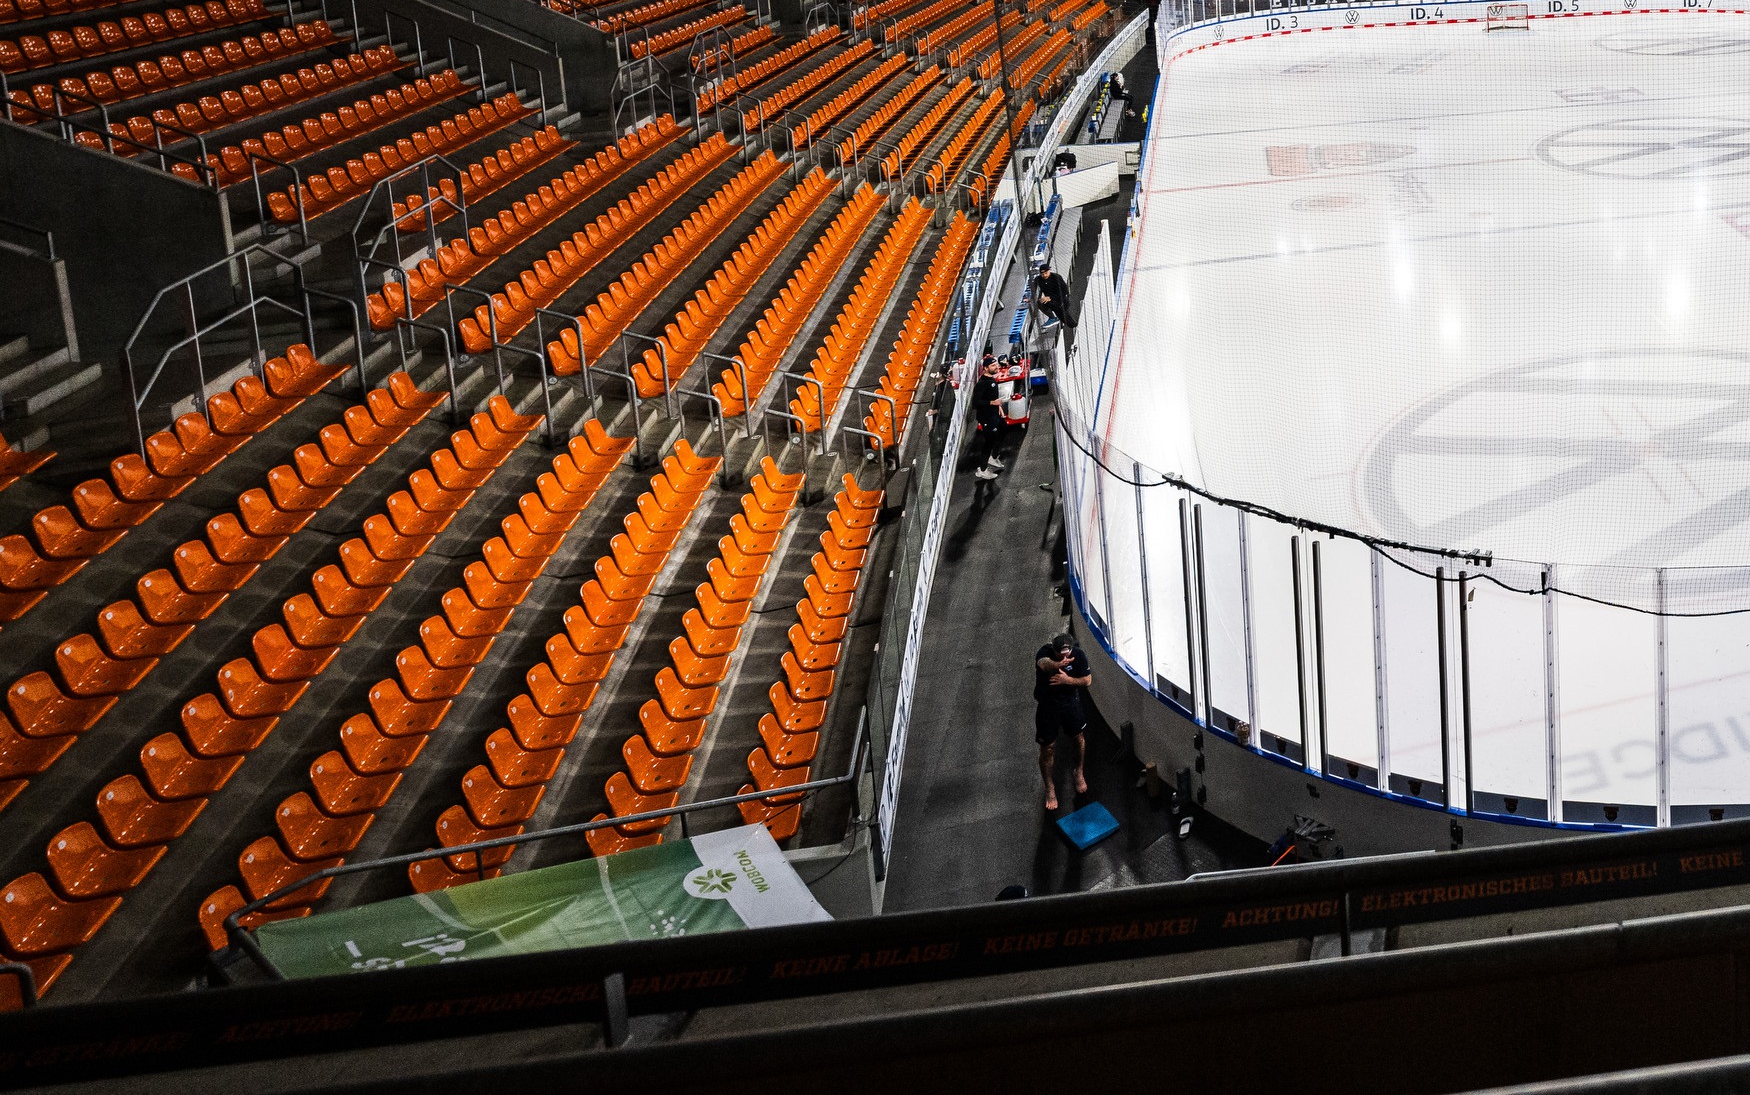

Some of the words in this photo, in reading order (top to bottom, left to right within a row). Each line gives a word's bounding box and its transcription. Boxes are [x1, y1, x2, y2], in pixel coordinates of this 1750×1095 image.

[1435, 6, 1444, 19] 4
[1571, 0, 1579, 11] 5
[1290, 15, 1298, 29] 3
[733, 849, 771, 894] WOBCOM
[982, 929, 1060, 956] KEINE
[1221, 896, 1341, 931] ACHTUNG!
[1360, 872, 1555, 914] ELEKTRONISCHES
[1559, 860, 1658, 893] BAUTEIL!
[1678, 848, 1742, 875] KEINE
